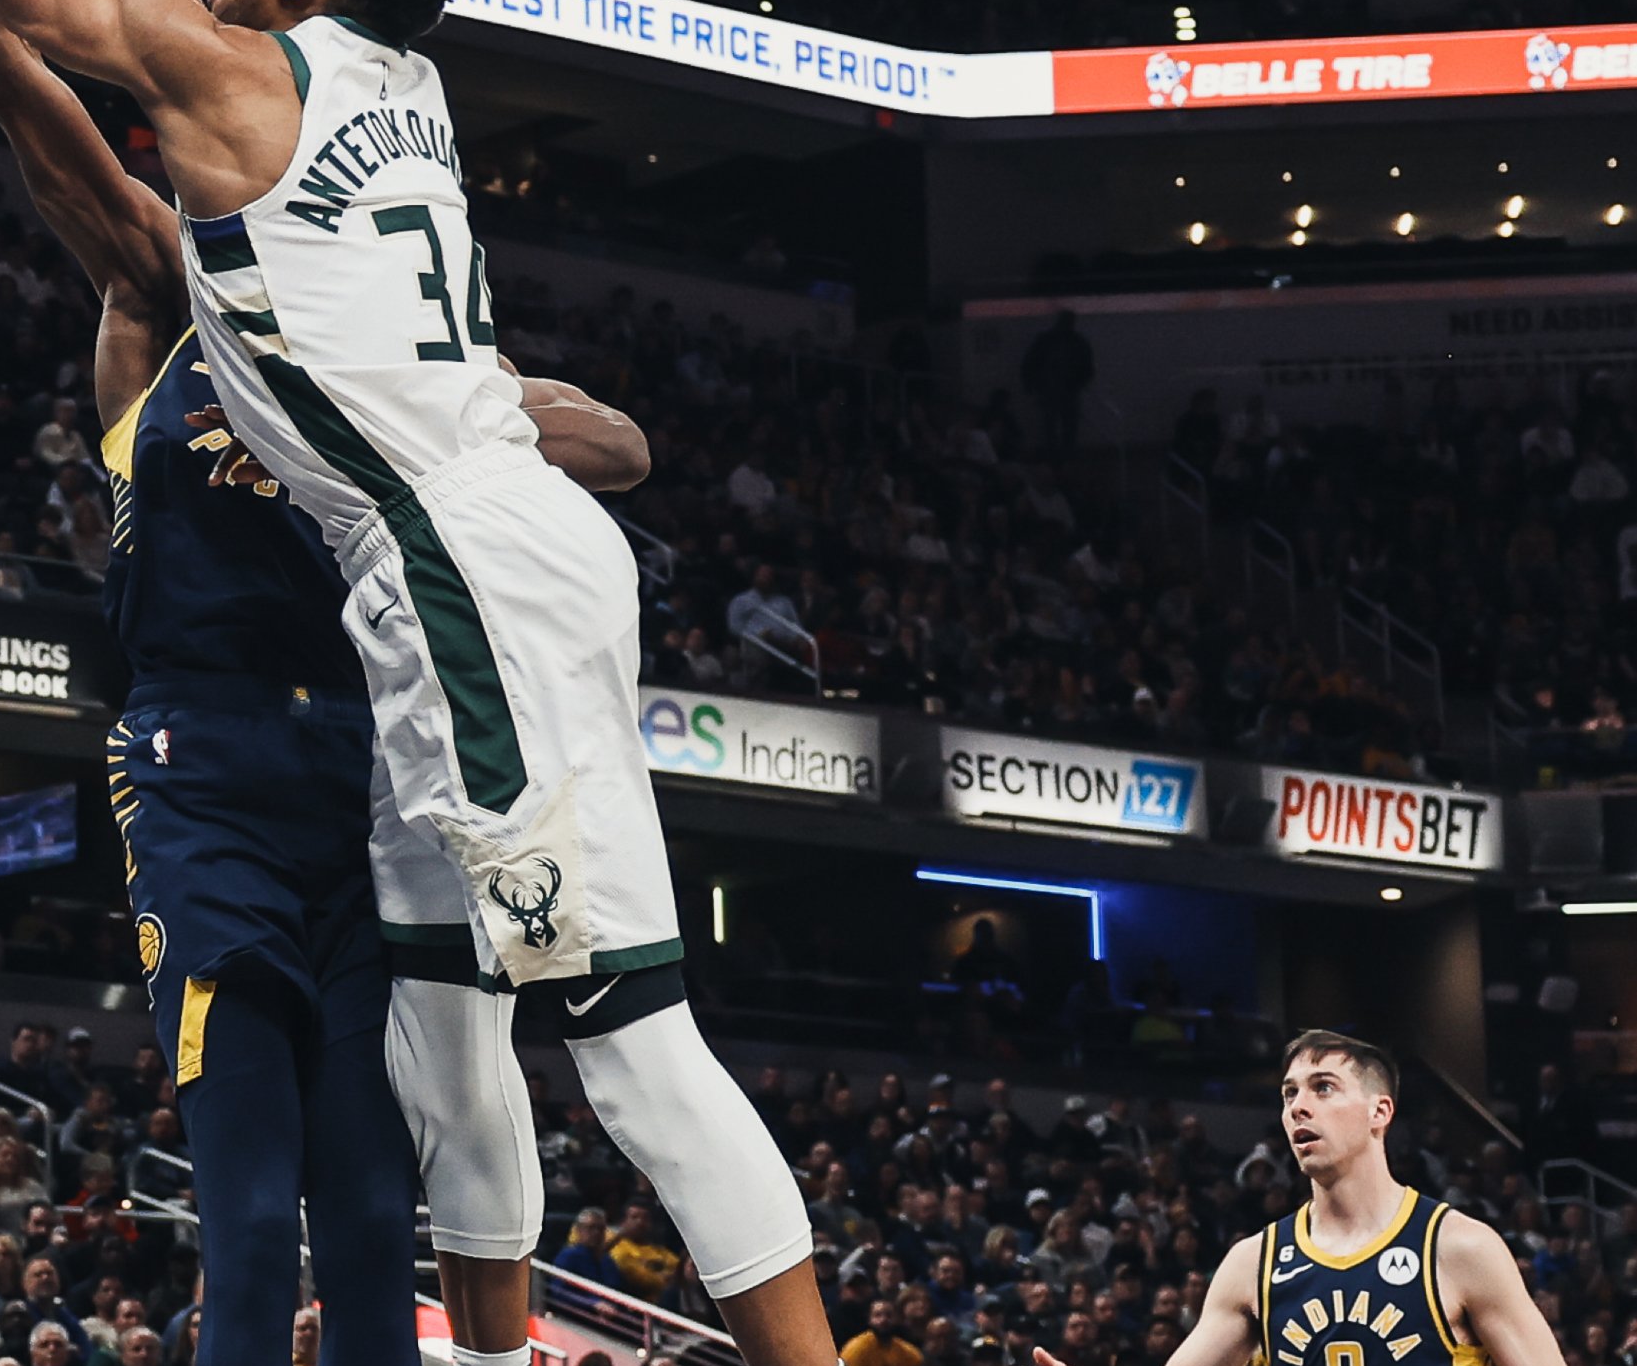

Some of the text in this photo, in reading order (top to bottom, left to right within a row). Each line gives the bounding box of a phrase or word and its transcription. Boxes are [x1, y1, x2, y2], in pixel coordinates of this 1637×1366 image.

[671, 12, 781, 72] PRICE,
[795, 40, 930, 100] PERIOD!
[1191, 54, 1433, 98] BELLE TIRE
[740, 729, 874, 791] Indiana
[951, 749, 1182, 817] SECTION 127
[1278, 776, 1488, 860] POINTSBET
[1279, 1245, 1295, 1263] 6
[1278, 1289, 1423, 1366] INDIANA
